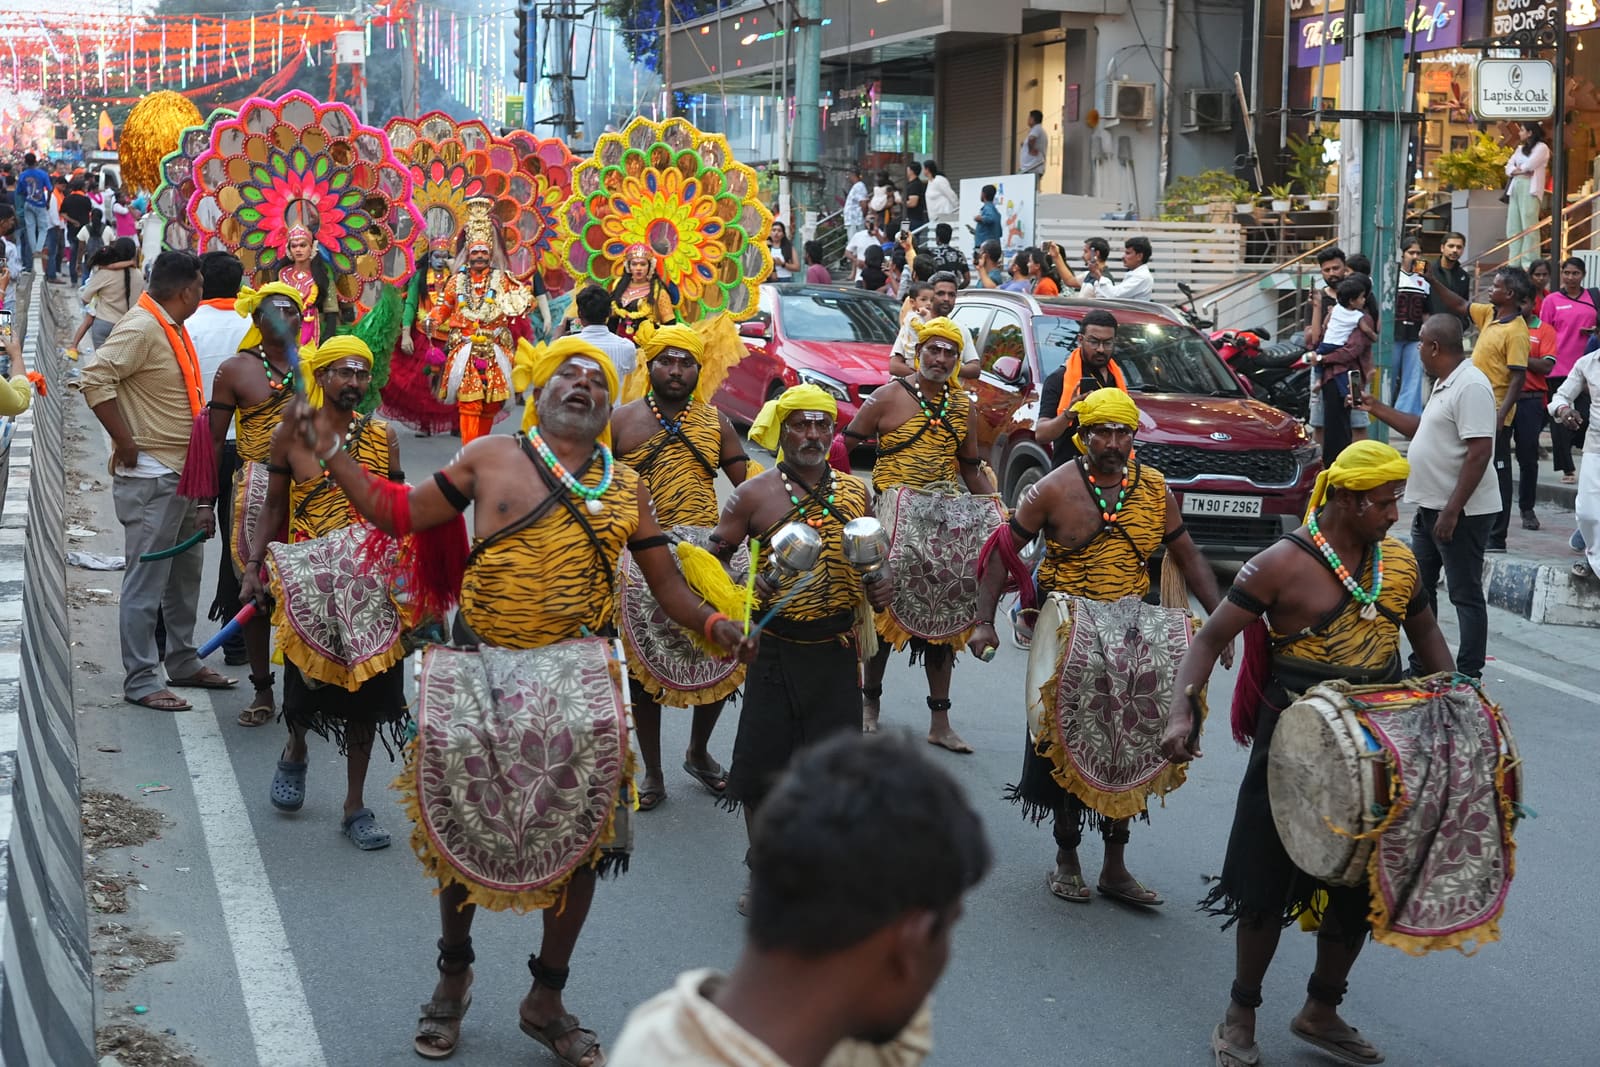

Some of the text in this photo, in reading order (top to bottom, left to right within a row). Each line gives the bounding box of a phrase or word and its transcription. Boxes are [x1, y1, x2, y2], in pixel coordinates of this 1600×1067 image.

[1483, 89, 1549, 105] Lapis & Oak
[1192, 499, 1259, 514] TN 90 F 2962
